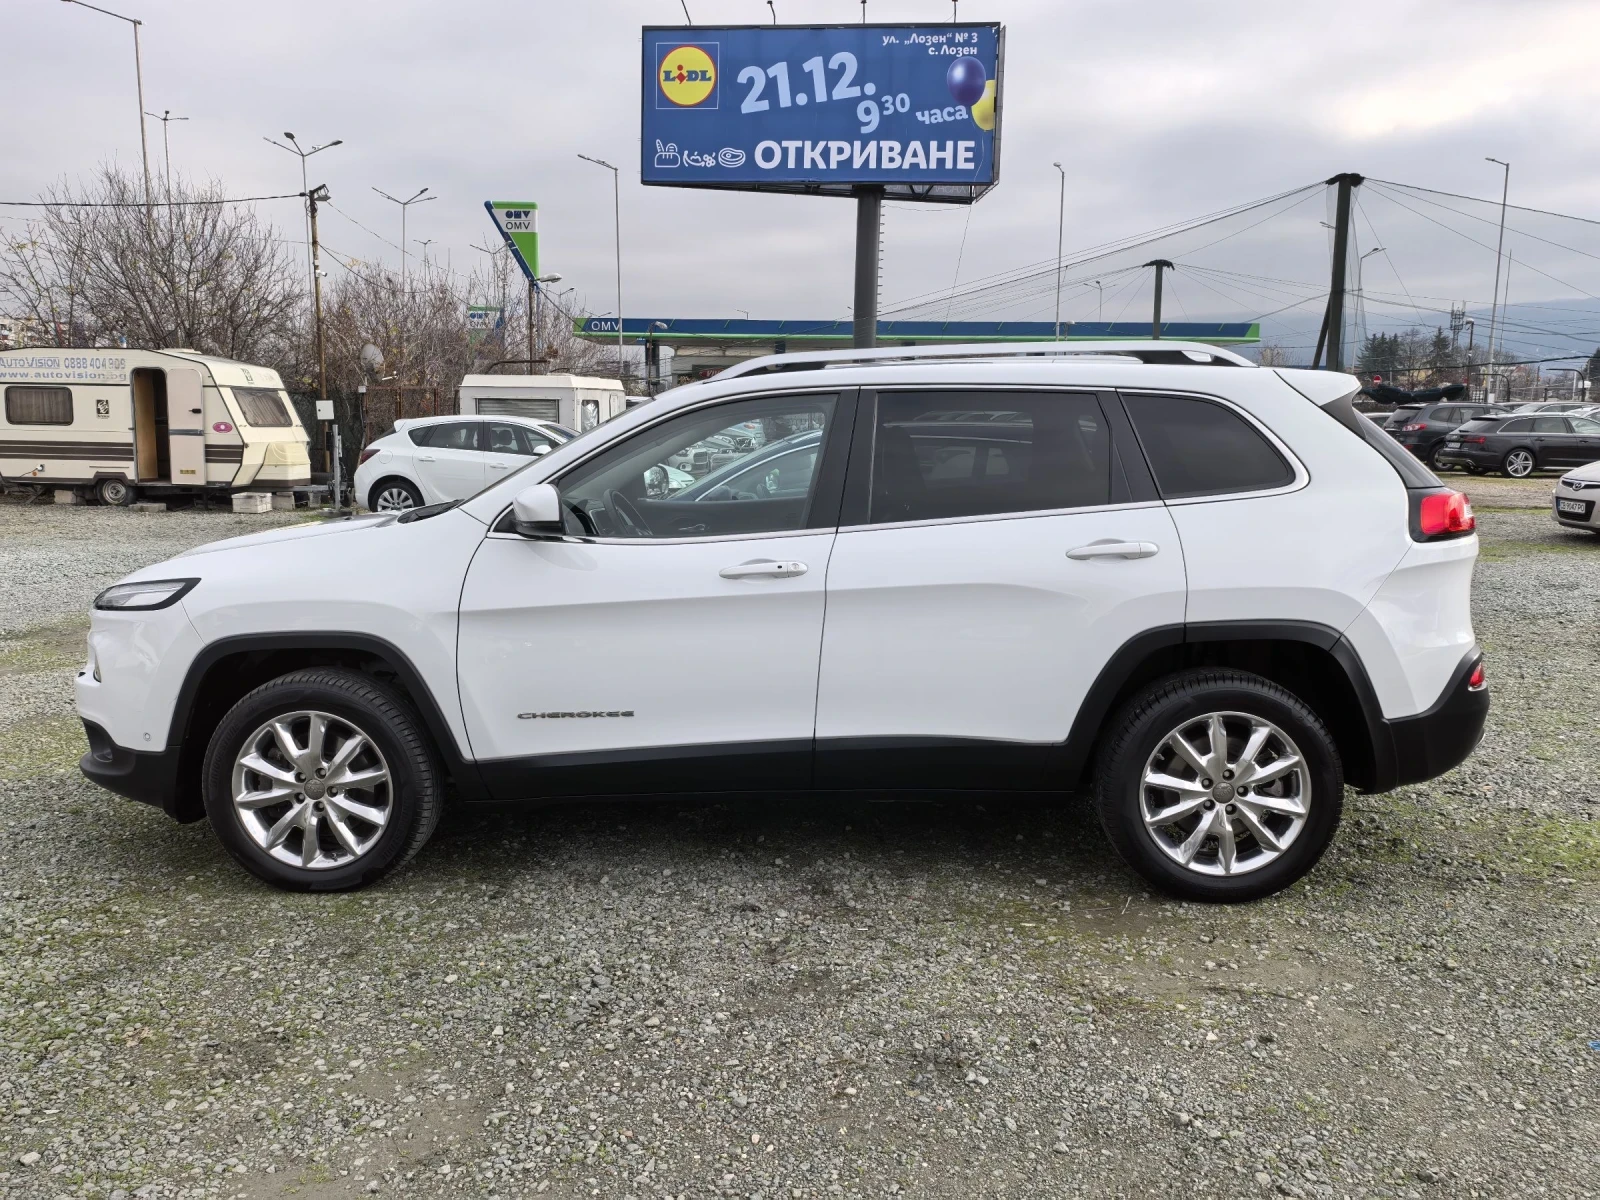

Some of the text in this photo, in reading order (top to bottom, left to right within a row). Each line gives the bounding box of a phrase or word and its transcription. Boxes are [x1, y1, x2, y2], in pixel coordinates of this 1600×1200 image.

[882, 34, 900, 46] ул.
[971, 32, 978, 43] 3
[928, 44, 978, 58] с. Лозен
[736, 51, 877, 115] 21.12.
[915, 103, 969, 125] часа
[754, 140, 976, 171] ОТКРИВАНЕ
[505, 221, 531, 230] OMV
[591, 321, 620, 331] OMV
[64, 357, 88, 369] 0888
[90, 357, 107, 370] 404
[517, 710, 635, 720] CHEROKEE
